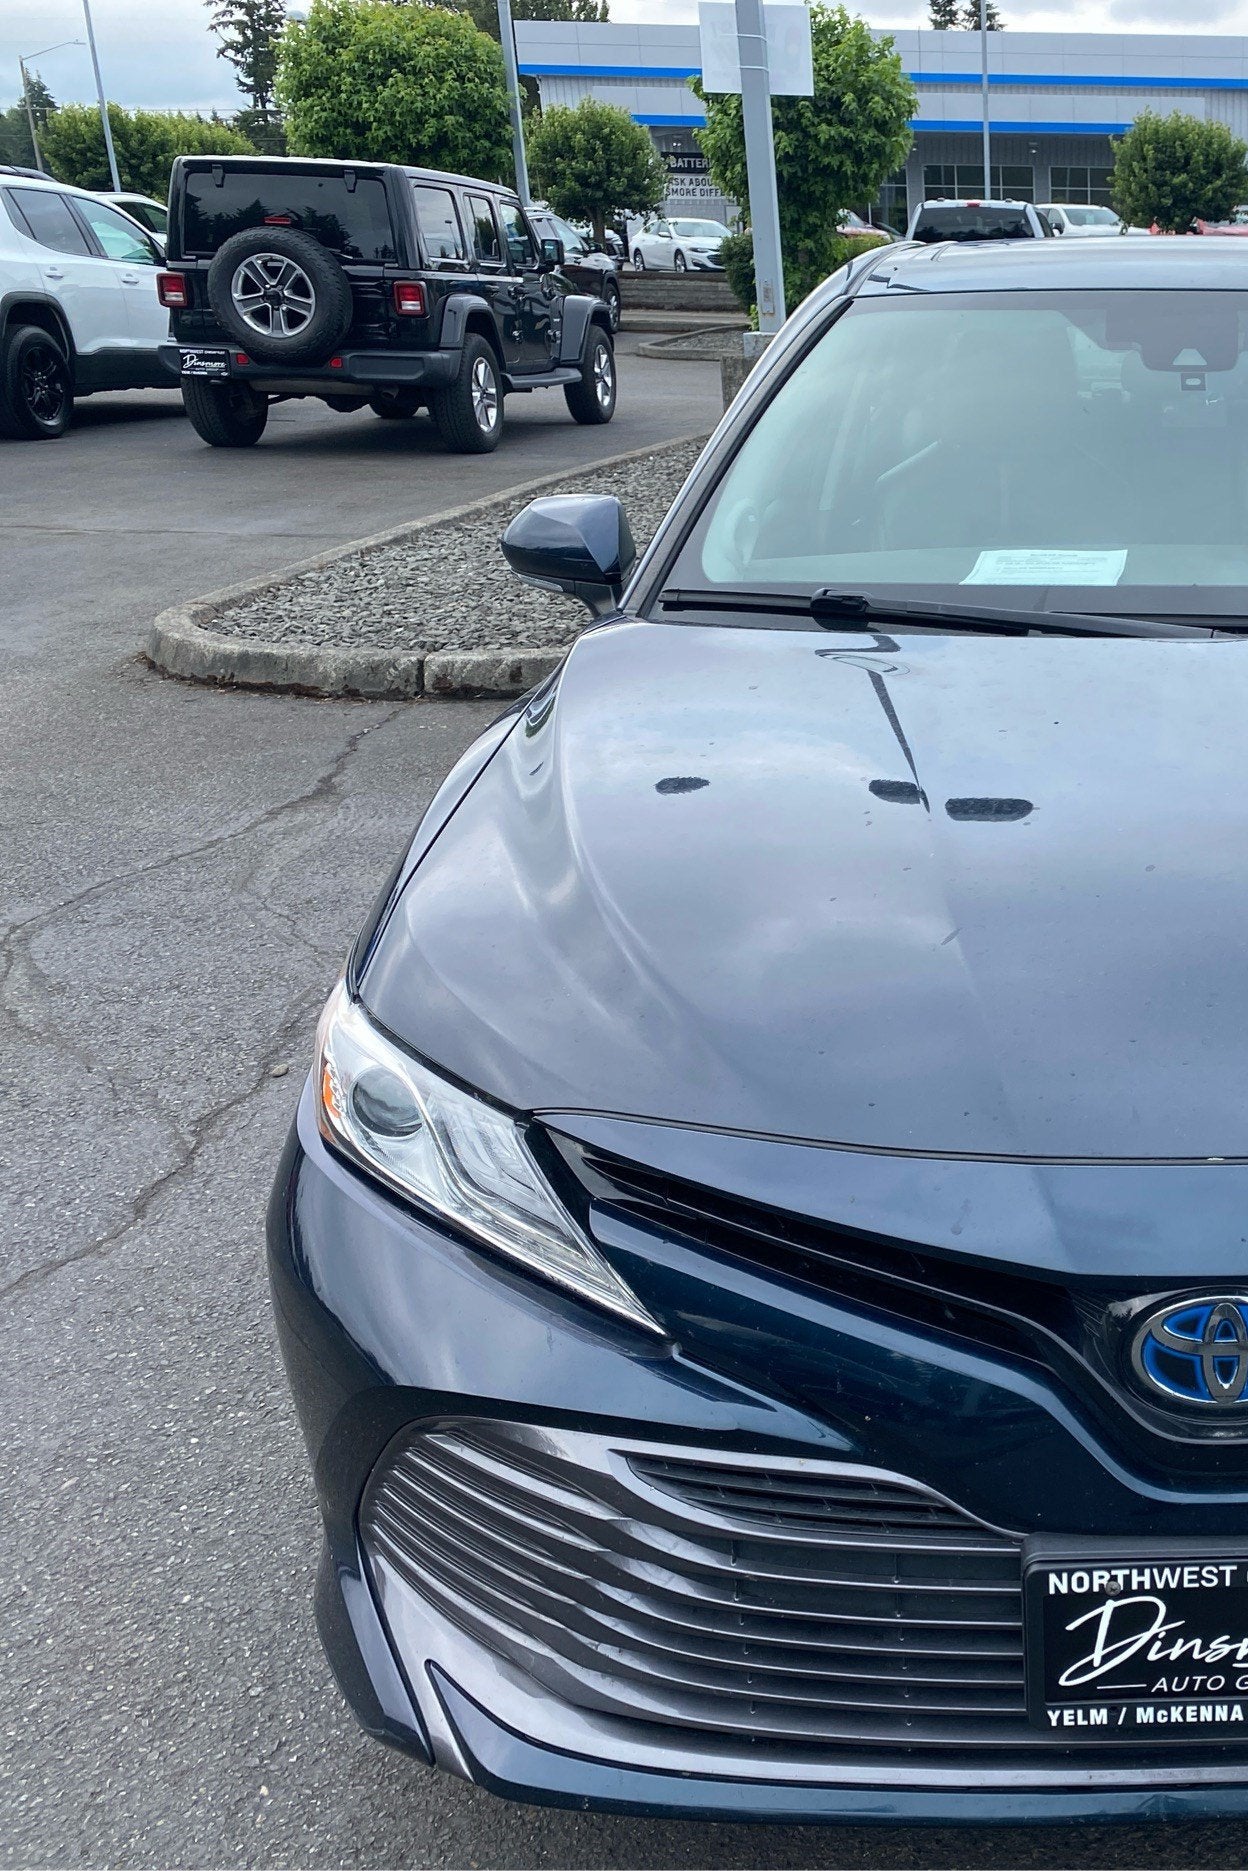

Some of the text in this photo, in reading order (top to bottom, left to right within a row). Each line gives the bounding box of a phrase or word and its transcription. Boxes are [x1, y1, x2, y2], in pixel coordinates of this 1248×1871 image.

[1048, 1565, 1237, 1594] NORTHWEST
[1151, 1675, 1226, 1692] AUTO
[1047, 1704, 1244, 1727] YELM / McKENNA
